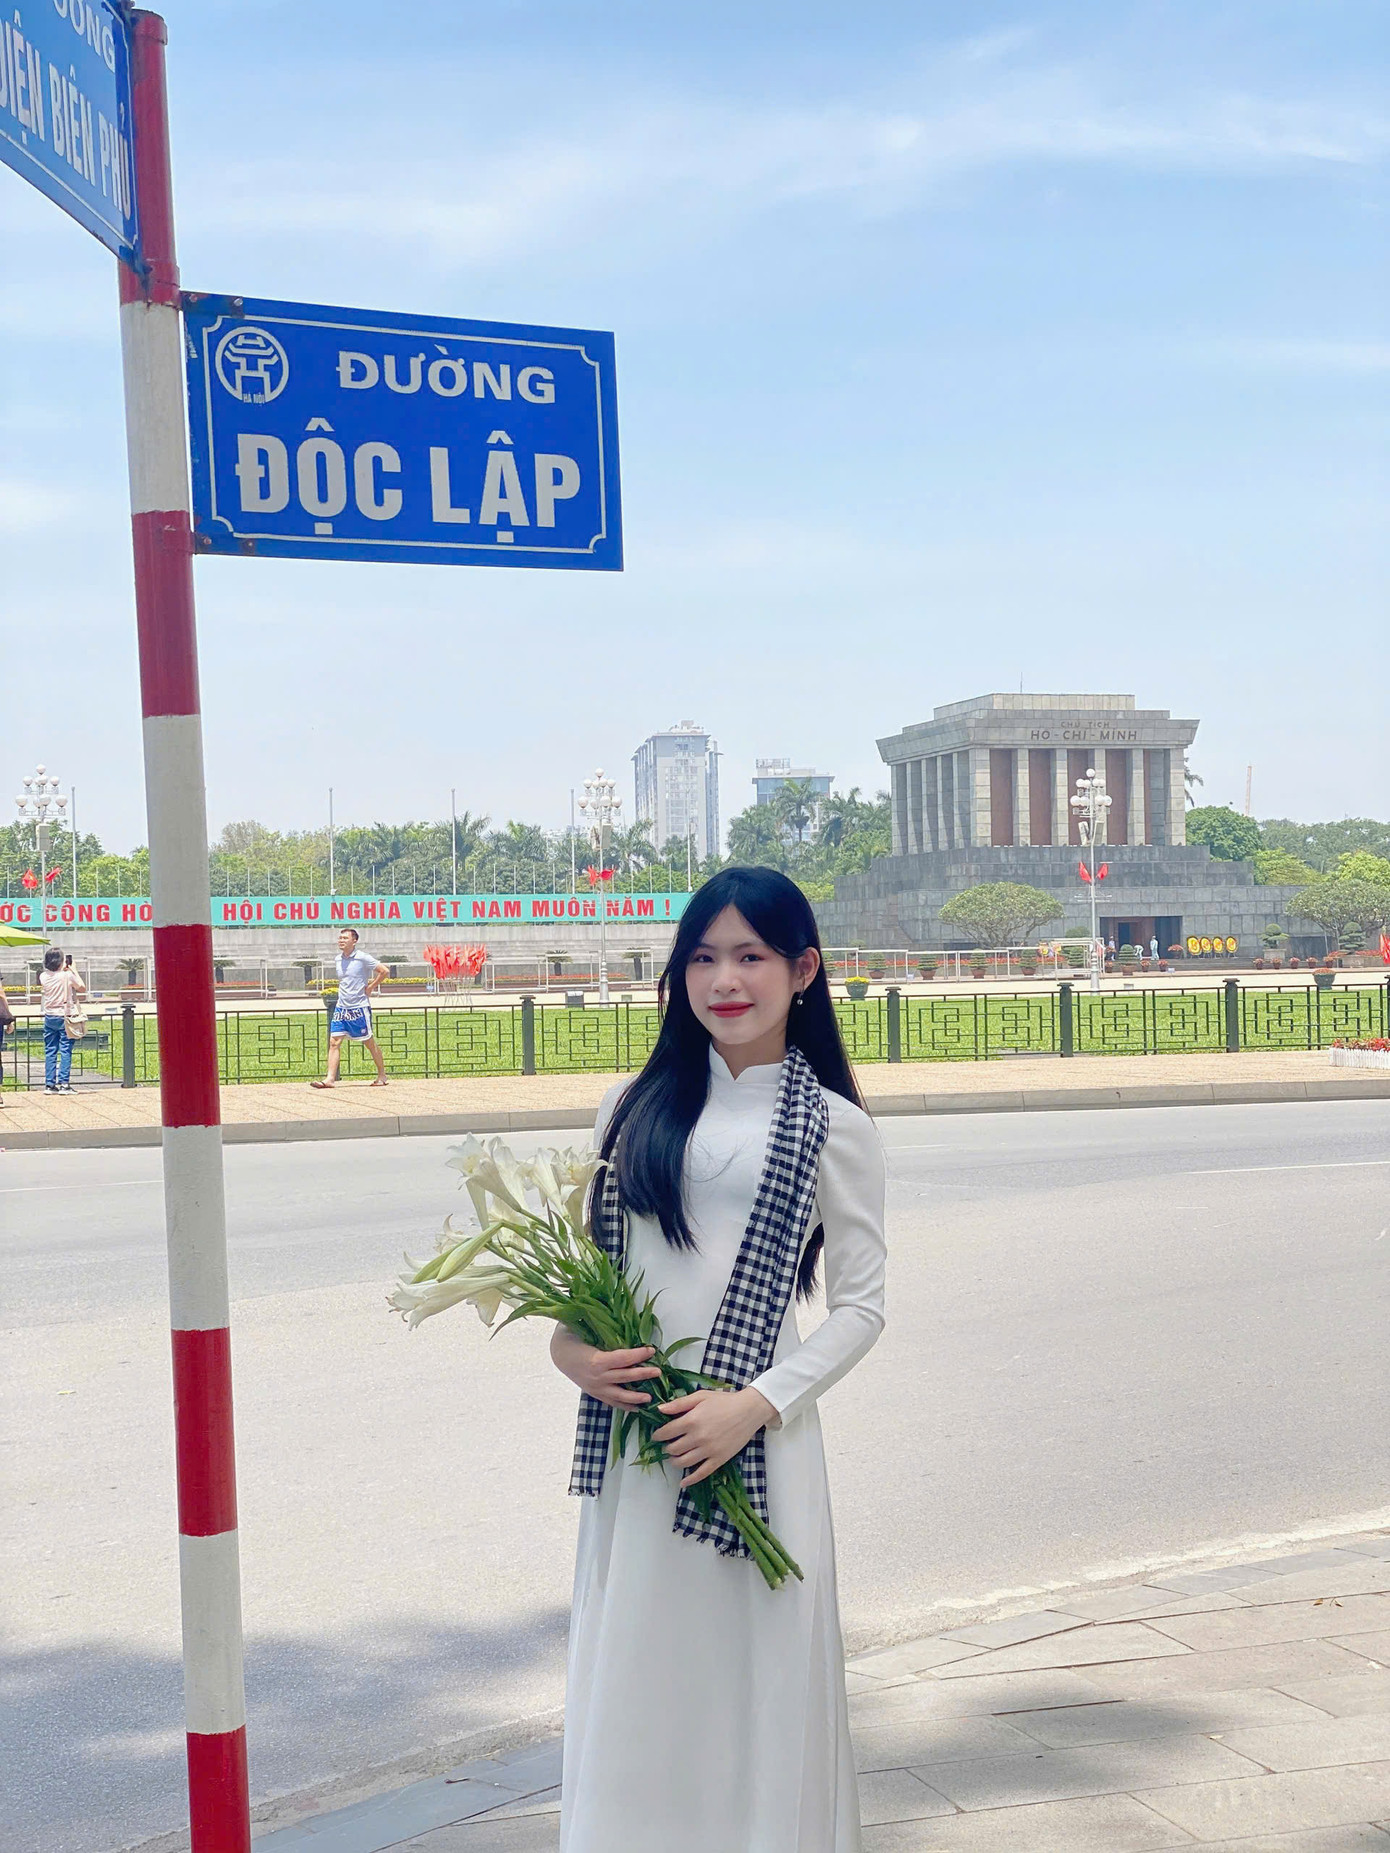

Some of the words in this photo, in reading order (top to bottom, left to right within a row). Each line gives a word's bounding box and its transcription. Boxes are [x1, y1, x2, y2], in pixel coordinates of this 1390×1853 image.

[49, 63, 96, 187] BIÊN
[98, 102, 131, 221] PHỦ
[336, 344, 556, 404] ĐƯỜNG
[235, 417, 403, 535] ĐỘC
[429, 430, 581, 543] LẬP
[46, 900, 110, 926] CỘNG
[223, 899, 262, 924] HỘI
[274, 897, 319, 920] CHỦ
[331, 898, 401, 920] NGHĨA
[413, 897, 461, 921] VIỆT
[472, 900, 521, 918] NAM
[532, 896, 596, 918] MUÔN
[606, 896, 654, 917] NĂM
